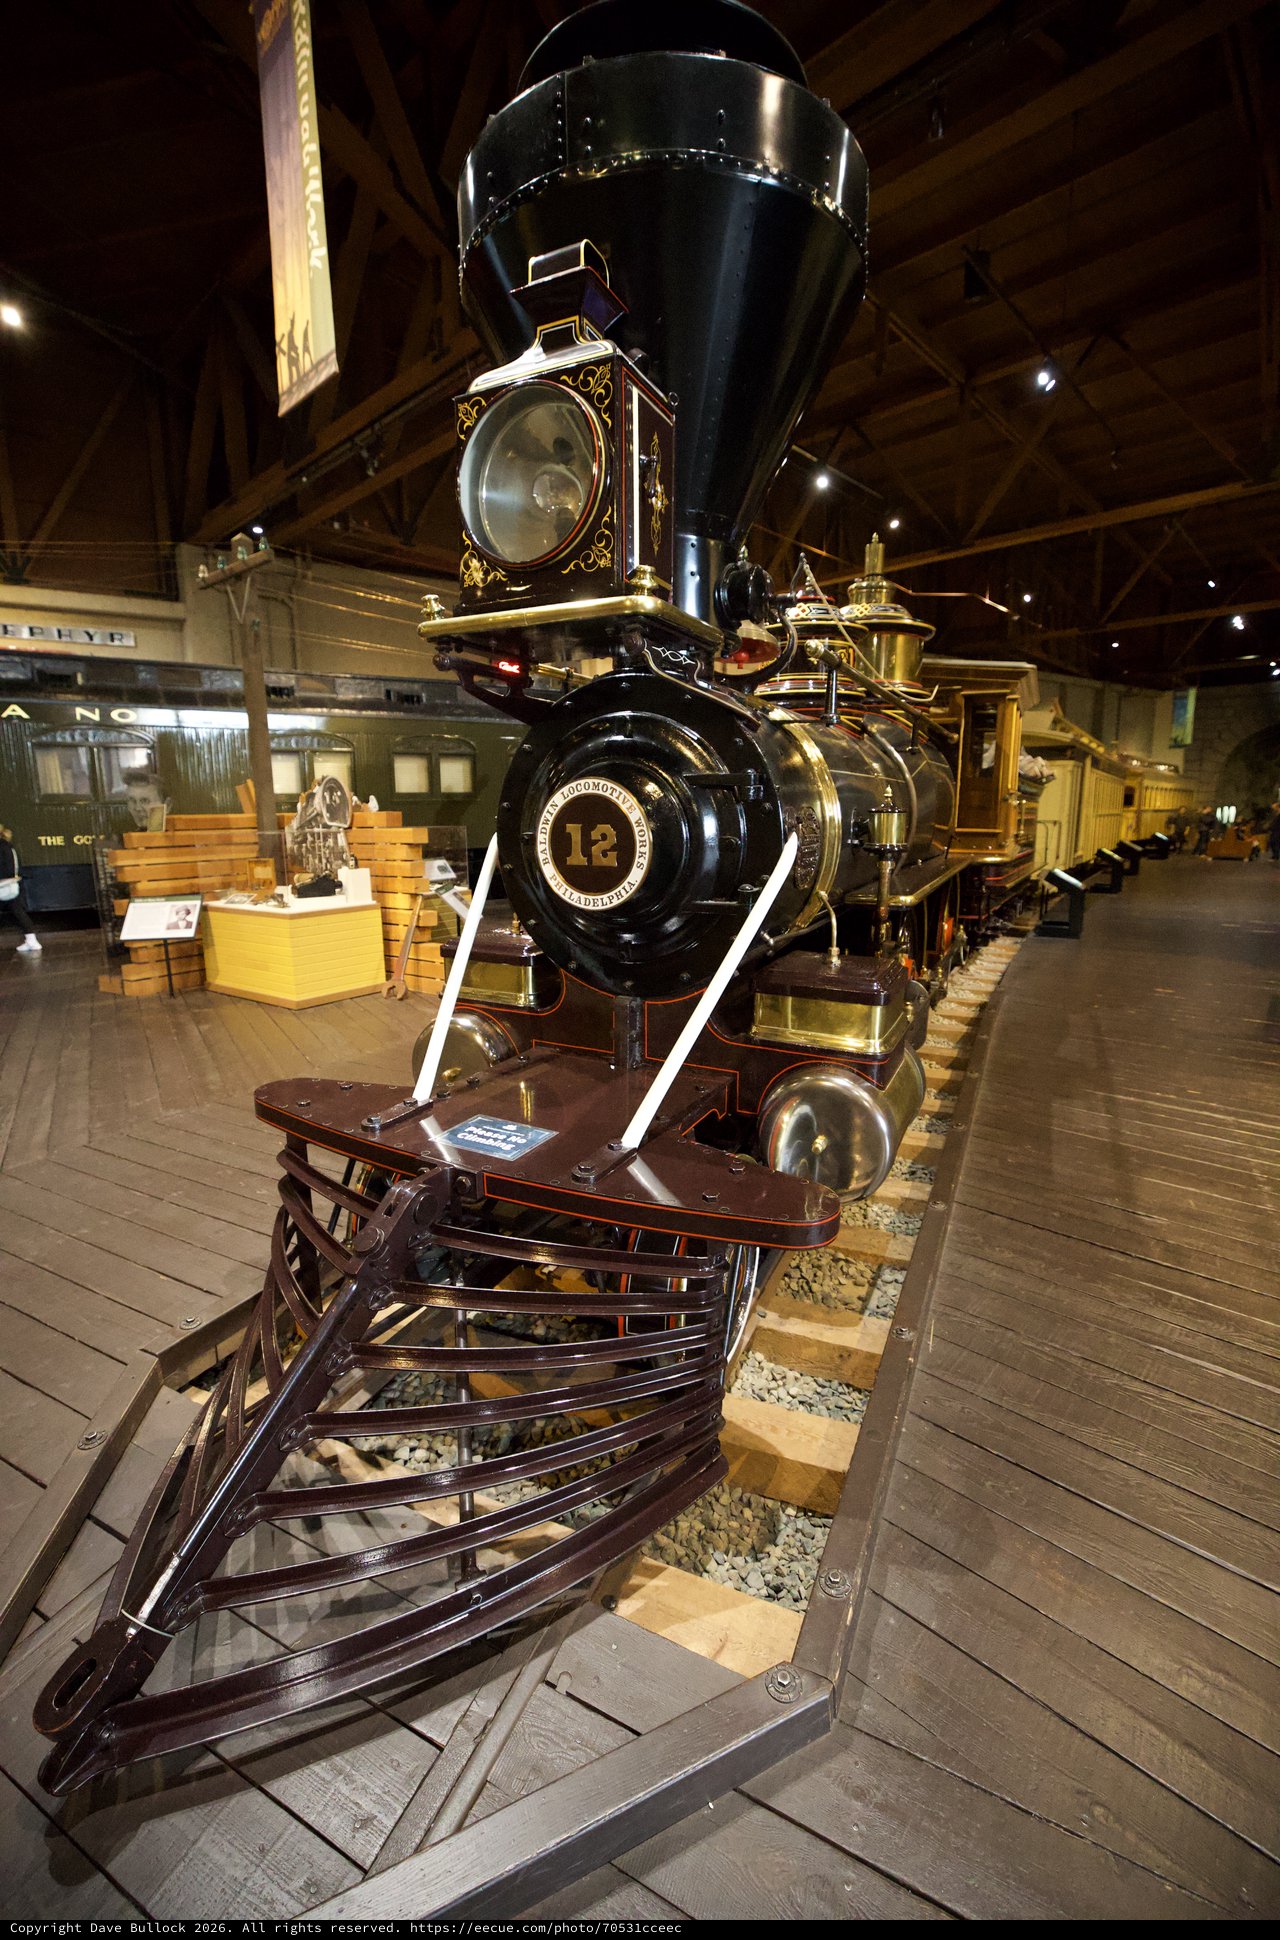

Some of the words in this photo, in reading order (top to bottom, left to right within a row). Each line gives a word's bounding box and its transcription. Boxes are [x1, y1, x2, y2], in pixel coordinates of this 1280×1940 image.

[540, 801, 560, 866] BALDWIN
[561, 781, 637, 814] LOCOMOTIVE
[634, 816, 648, 871] WORKS
[38, 836, 65, 846] THE
[73, 835, 105, 846] GO
[565, 823, 618, 867] 12
[549, 873, 638, 908] PHILADELPHIA.
[457, 1133, 516, 1150] Climbing
[464, 1126, 507, 1140] Please
[507, 1135, 528, 1144] No
